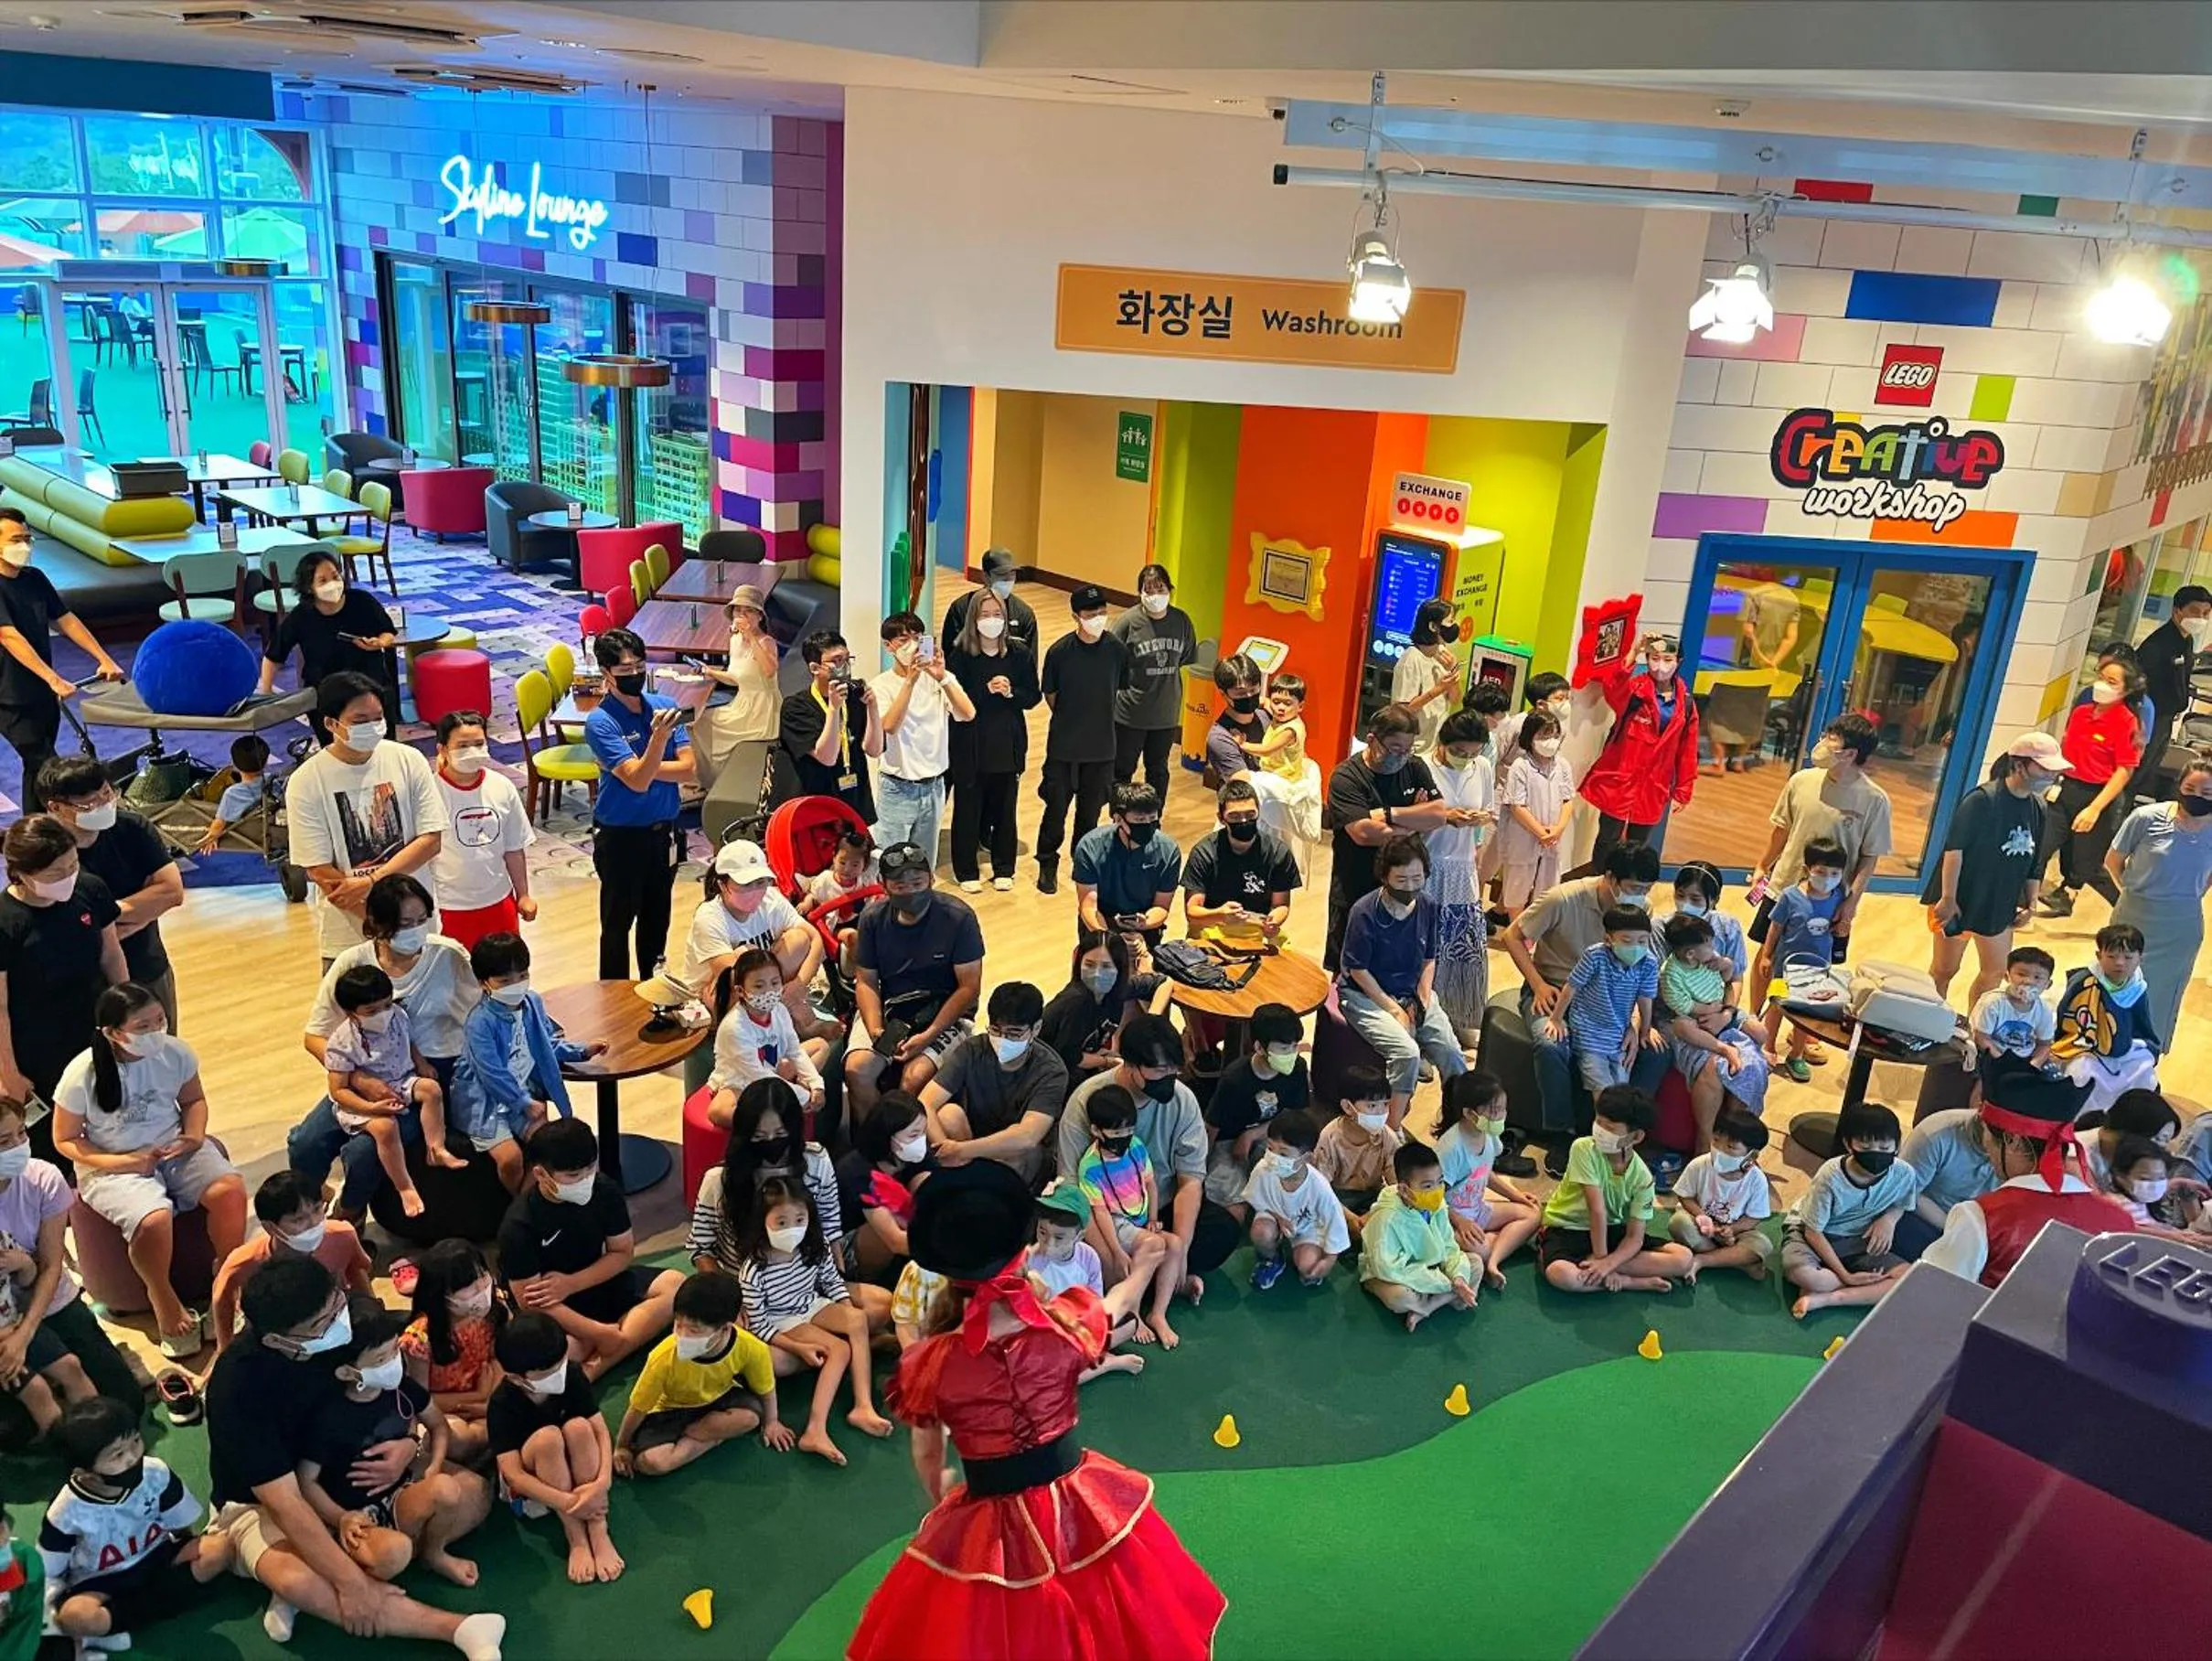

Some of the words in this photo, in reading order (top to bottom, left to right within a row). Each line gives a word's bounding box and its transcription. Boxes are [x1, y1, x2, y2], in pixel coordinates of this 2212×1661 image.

[438, 155, 526, 235] Skyline
[526, 161, 608, 250] Lounge
[1117, 290, 1233, 339] 화장실
[1262, 308, 1402, 339] Washroom
[1883, 362, 1933, 387] LEGO
[1400, 481, 1462, 501] EXCHANGE
[1802, 483, 1965, 531] workshop
[2098, 1241, 2212, 1303] LEG
[98, 1522, 162, 1571] AIA
